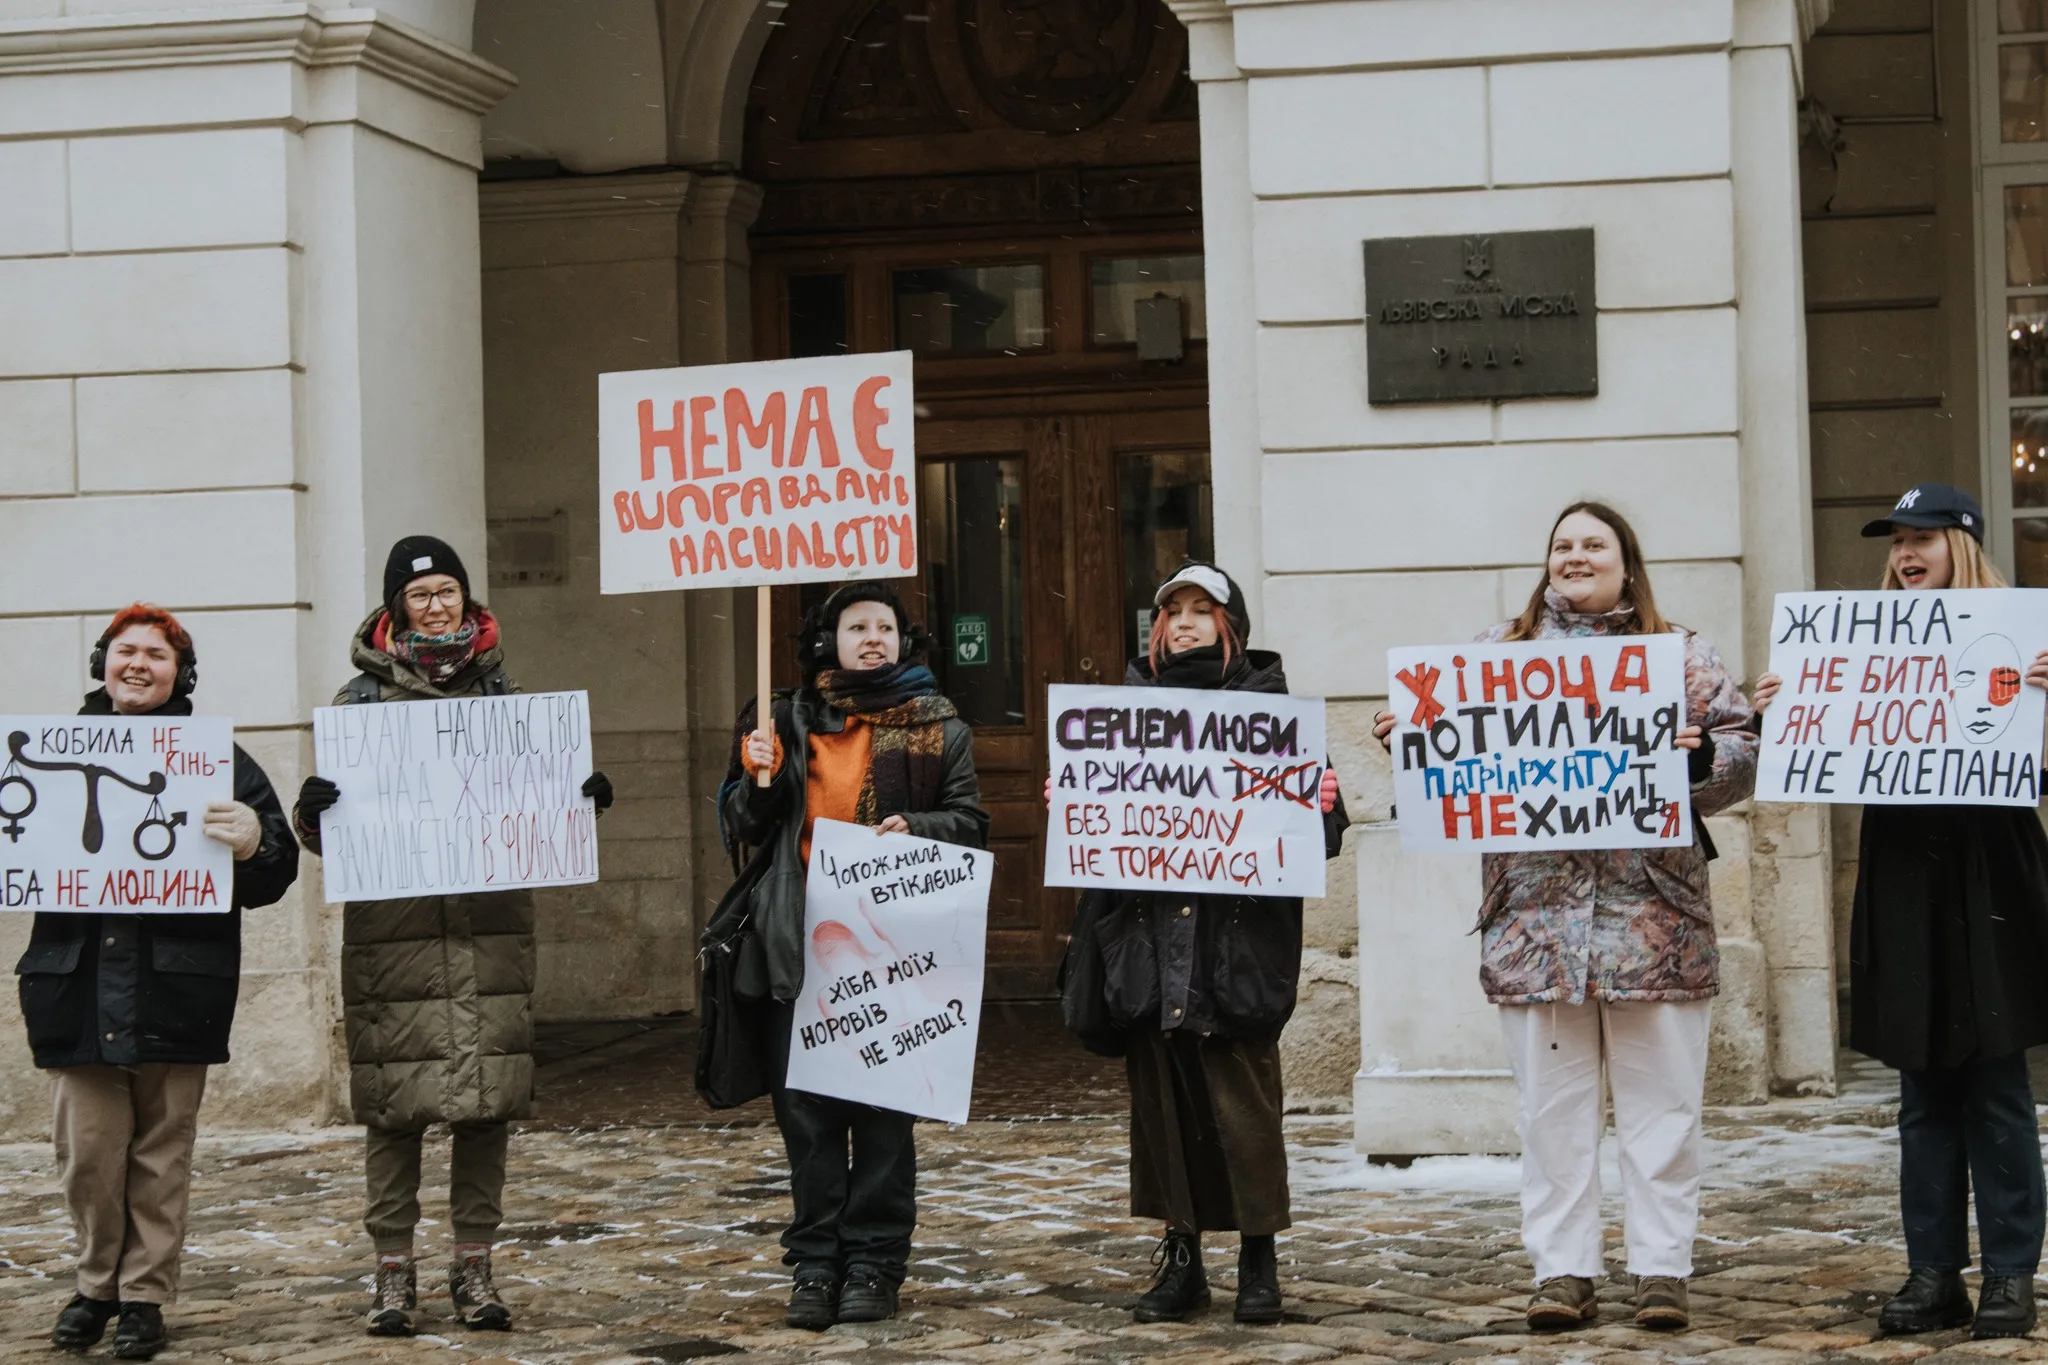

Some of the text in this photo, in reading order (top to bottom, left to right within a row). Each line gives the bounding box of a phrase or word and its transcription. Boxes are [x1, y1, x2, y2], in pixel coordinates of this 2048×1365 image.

[1379, 292, 1581, 325] ЛЬВІВСЬКА МІСЬКА
[637, 375, 894, 481] НЕМАЄ
[613, 467, 909, 533] ВИПРАВДАНЬ
[1895, 488, 1921, 510] NY
[669, 513, 915, 577] НАСИЛЬСТВУ
[1395, 644, 1650, 730] ЖІНОЧА
[1798, 657, 1849, 694] НЕ
[41, 727, 182, 754] КОБИЛА НЕ
[321, 694, 581, 769] НЕХАЙ НАСИЛЬСТВО
[1056, 707, 1194, 758] СЕРЦЕМ
[1402, 702, 1678, 770] ПОТИЛИЦЯ
[1776, 698, 1947, 745] ЯК КОСА
[376, 752, 576, 822] НАД ЖІНКАМИ
[1058, 762, 1077, 789] А
[1084, 760, 1219, 799] РУКАМИ
[1424, 750, 1629, 799] ПАТРІАРХАТУ
[1784, 749, 2036, 799] НЕ КЛЕПАНА
[481, 813, 495, 883] В
[500, 808, 597, 881] ФОЛЬКЛОРІ
[1066, 802, 1243, 846] БЕЗ ДОЗВОЛУ
[1070, 844, 1104, 877] НЕ
[57, 869, 89, 907] НЕ
[99, 870, 218, 907] ЛЮДИНА
[800, 1002, 888, 1050] НОРОВІВ
[859, 1041, 888, 1069] НЕ
